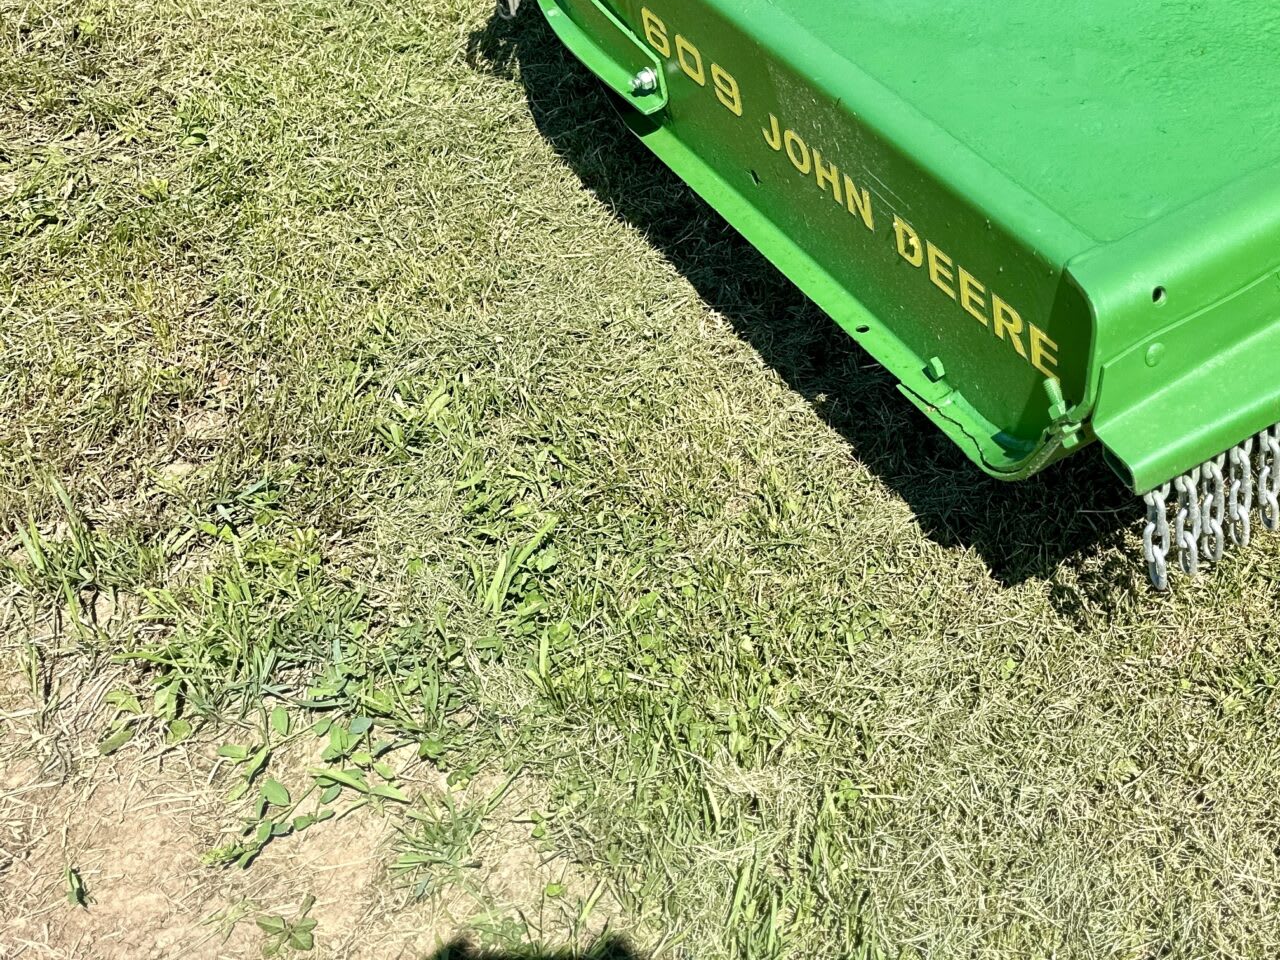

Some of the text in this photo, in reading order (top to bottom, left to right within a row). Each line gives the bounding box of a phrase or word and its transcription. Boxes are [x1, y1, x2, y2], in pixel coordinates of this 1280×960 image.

[641, 6, 1060, 385] 609 JOHN DEERE
